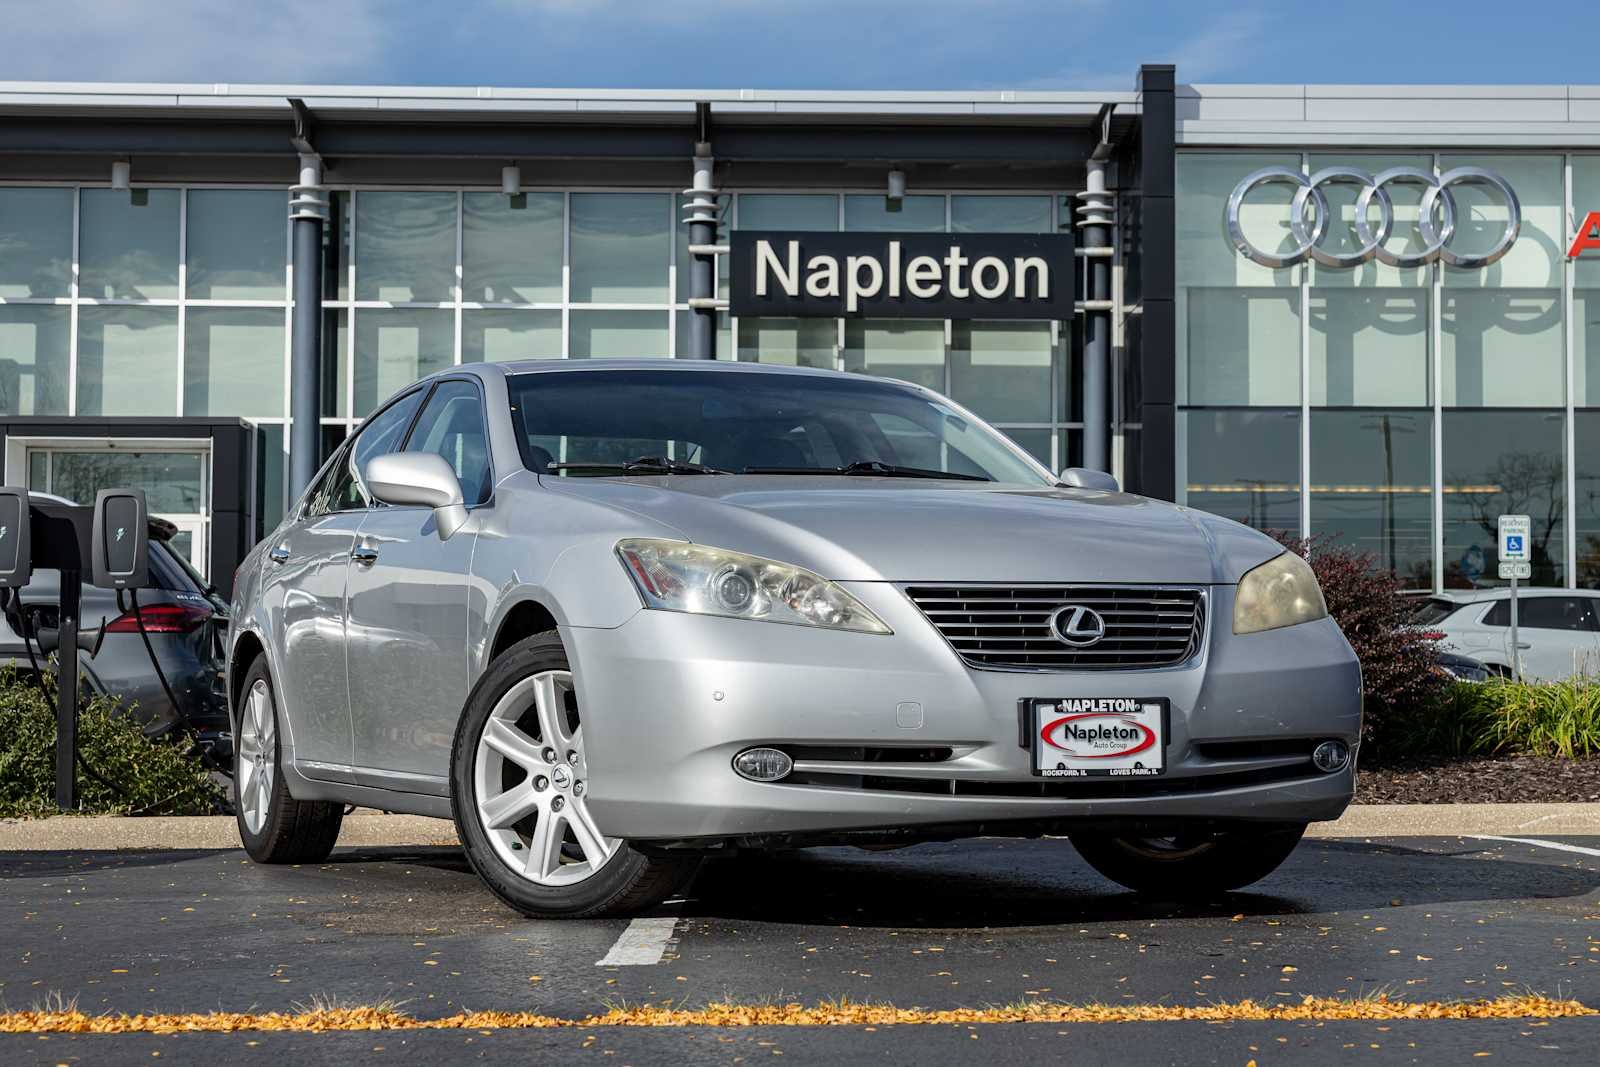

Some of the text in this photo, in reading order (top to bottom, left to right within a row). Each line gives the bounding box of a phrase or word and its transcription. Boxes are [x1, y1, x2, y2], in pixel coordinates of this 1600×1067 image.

[755, 240, 1049, 312] Napleton
[1062, 699, 1136, 712] NAPLETON
[1064, 724, 1139, 743] Napleton
[1094, 741, 1128, 750] Auto Group
